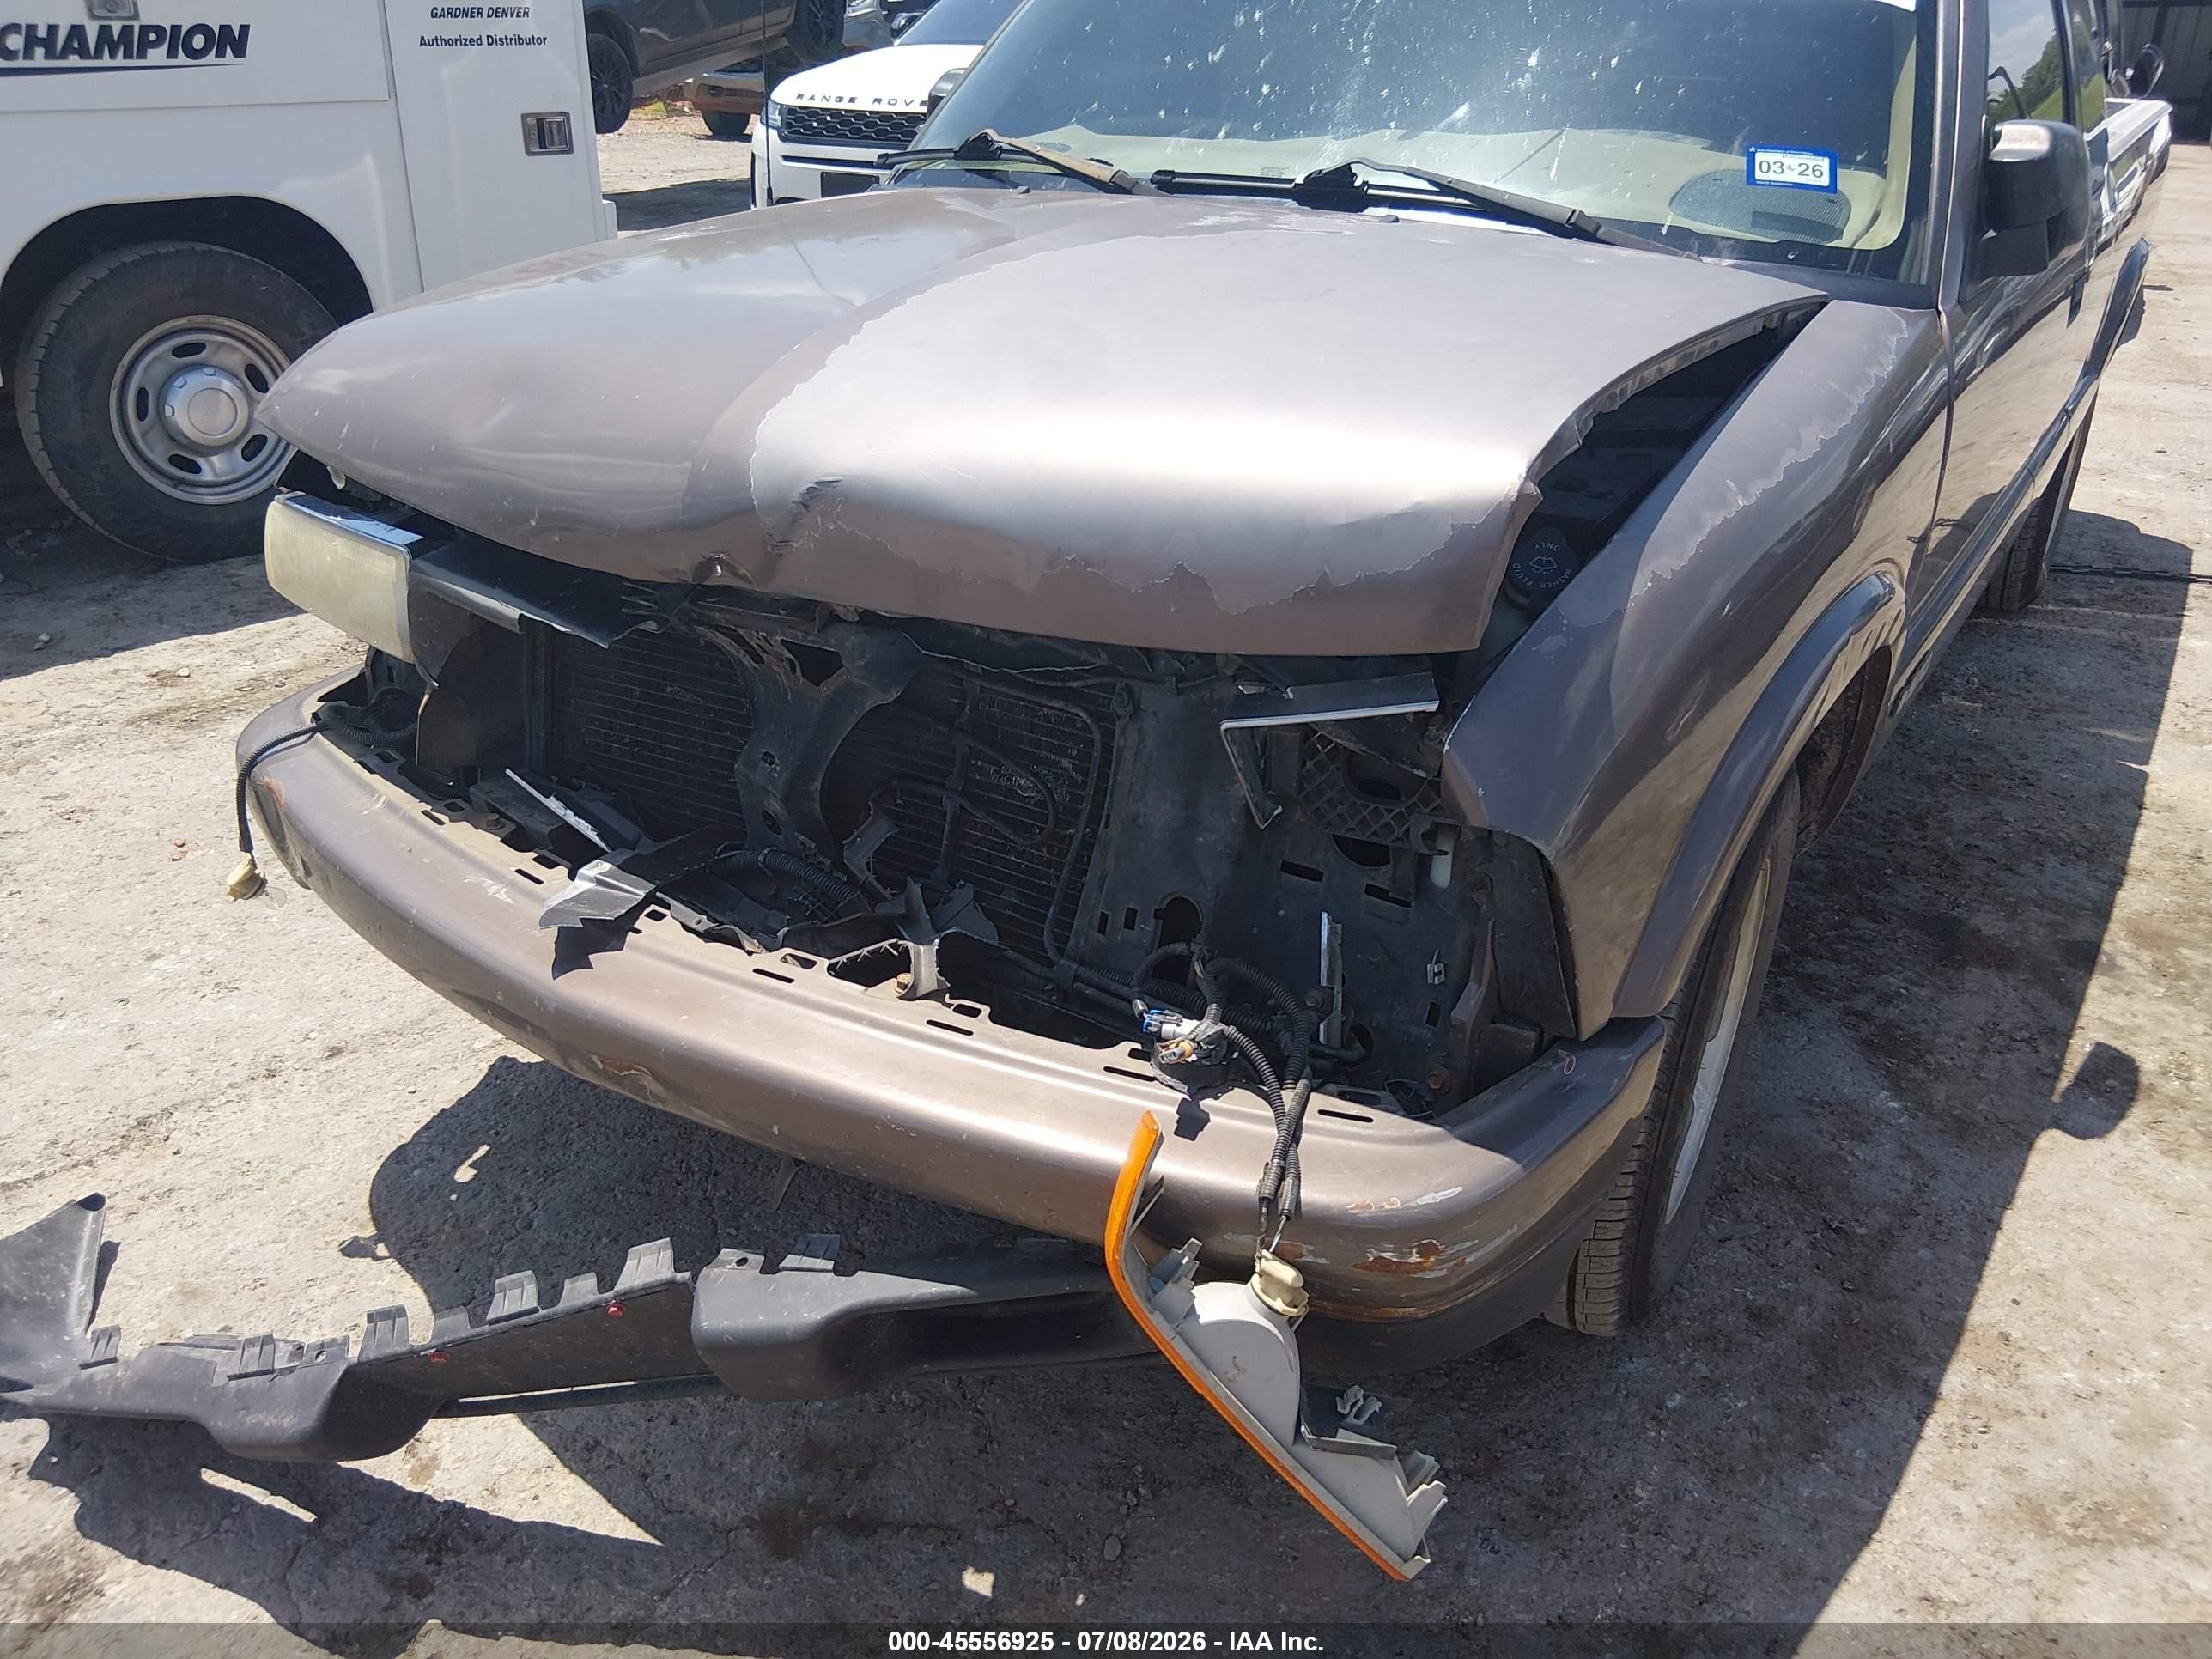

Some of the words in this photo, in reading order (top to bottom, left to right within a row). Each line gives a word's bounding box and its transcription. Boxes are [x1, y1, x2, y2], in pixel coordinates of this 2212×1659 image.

[430, 6, 483, 19] GARDNER
[486, 6, 531, 19] DENVER
[0, 22, 251, 62] CHAMPION
[419, 34, 483, 47] Authorized
[486, 33, 548, 46] Distributor
[796, 94, 858, 104] RANGE
[872, 97, 928, 107] ROVE
[1759, 160, 1785, 175] 03
[1797, 162, 1824, 179] 26
[1534, 542, 1560, 551] ONLY
